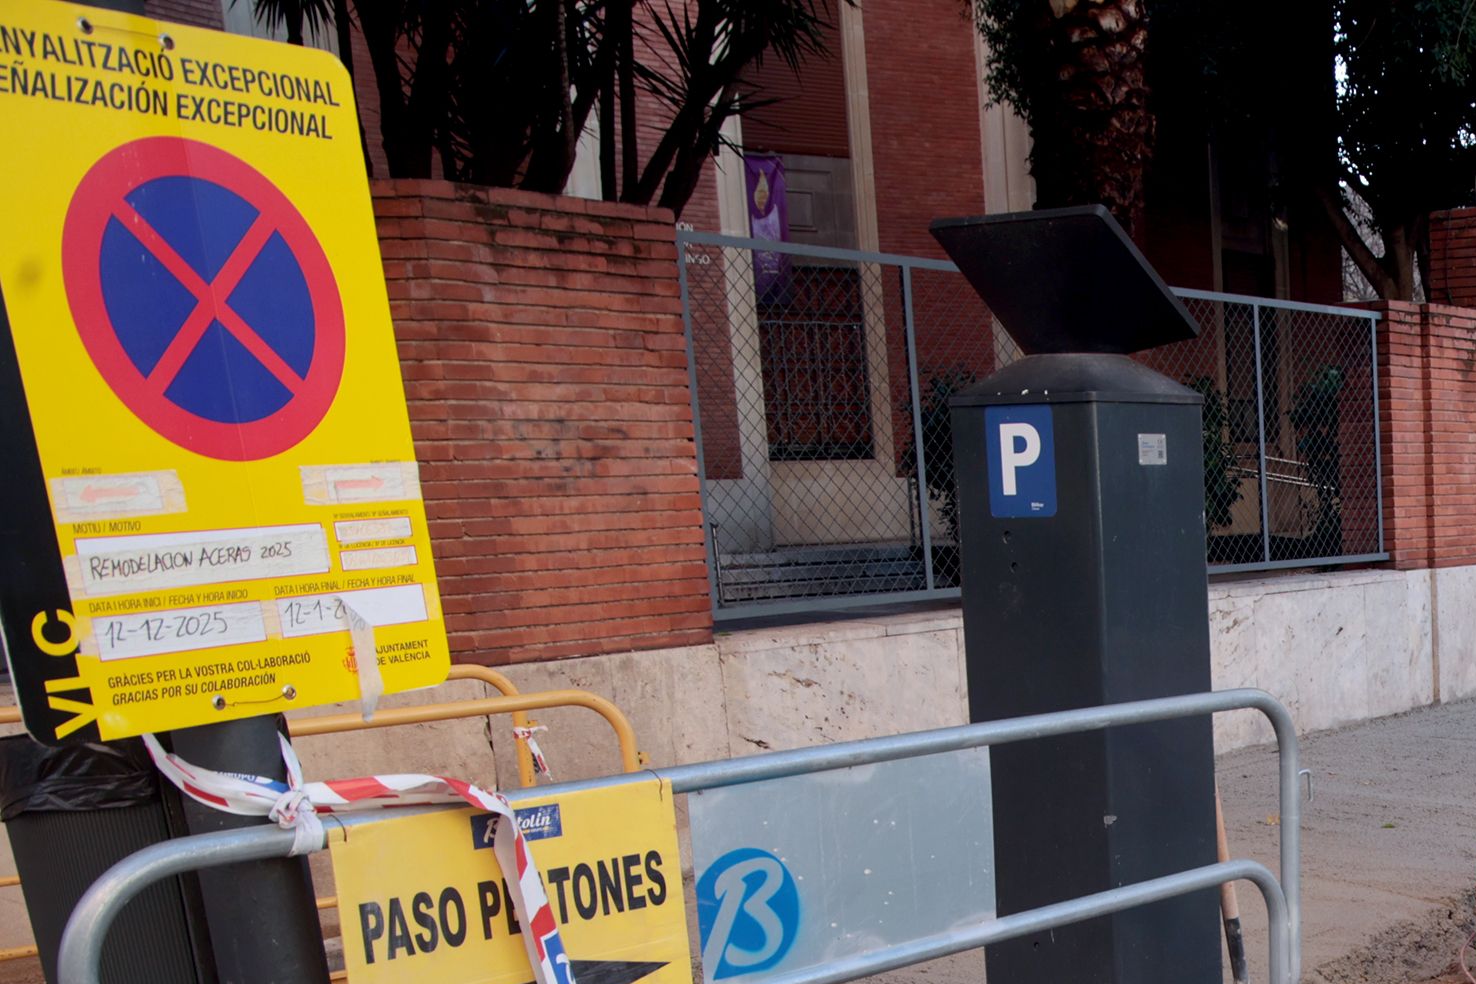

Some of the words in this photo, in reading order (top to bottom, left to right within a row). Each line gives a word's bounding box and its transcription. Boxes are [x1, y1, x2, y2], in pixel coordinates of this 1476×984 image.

[0, 24, 174, 81] NYALITZACIÓ
[181, 58, 341, 107] EXCEPCIONAL
[176, 93, 333, 140] EXCEPCIONAL
[999, 422, 1042, 496] P
[73, 523, 101, 534] MOTIU
[109, 521, 142, 533] MOTIVO
[199, 545, 252, 567] ACERAS
[260, 541, 292, 559] 2025
[89, 602, 112, 613] DATA
[118, 599, 142, 610] HORA
[168, 594, 195, 606] FECHA
[196, 592, 202, 602] Y
[203, 590, 225, 601] HORA
[226, 588, 249, 600] INICIO
[274, 585, 296, 596] DATA
[300, 581, 320, 592] HORA
[321, 579, 340, 590] FINAL
[347, 576, 371, 588] FECHA
[371, 576, 376, 586] Y
[376, 575, 397, 586] HORA
[397, 573, 416, 583] FINAL
[105, 611, 228, 649] 12-12-2025
[31, 607, 98, 741] VLC
[108, 671, 154, 689] GRÀCIES
[157, 669, 177, 683] PER
[179, 667, 193, 680] LA
[194, 663, 235, 678] VOSTRA
[112, 689, 159, 706] GRACIAS
[162, 686, 182, 699] POR
[185, 684, 198, 696] SU
[200, 673, 276, 694] COLABORACIÓN
[483, 811, 552, 844] Btolin
[358, 886, 467, 965] PASO
[479, 849, 668, 941] PETONES
[702, 857, 784, 980] B
